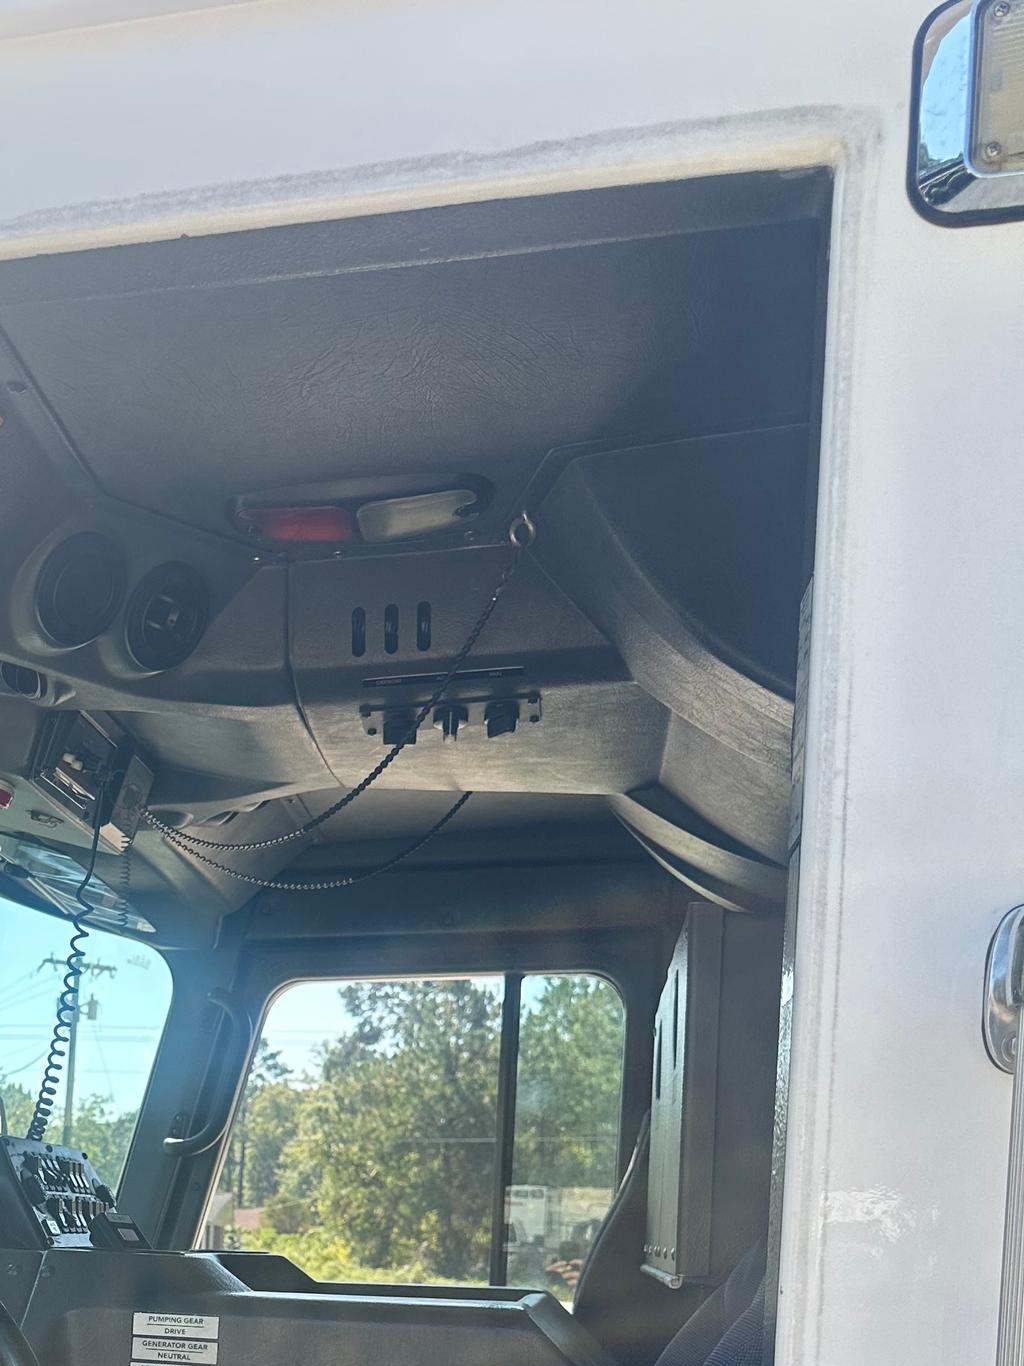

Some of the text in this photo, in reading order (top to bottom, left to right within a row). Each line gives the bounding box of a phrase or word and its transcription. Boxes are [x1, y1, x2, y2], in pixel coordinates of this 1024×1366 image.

[148, 1316, 204, 1325] PUMPING GEAR
[142, 1340, 186, 1349] GENERATOR
[157, 1352, 191, 1361] NEUTRAL
